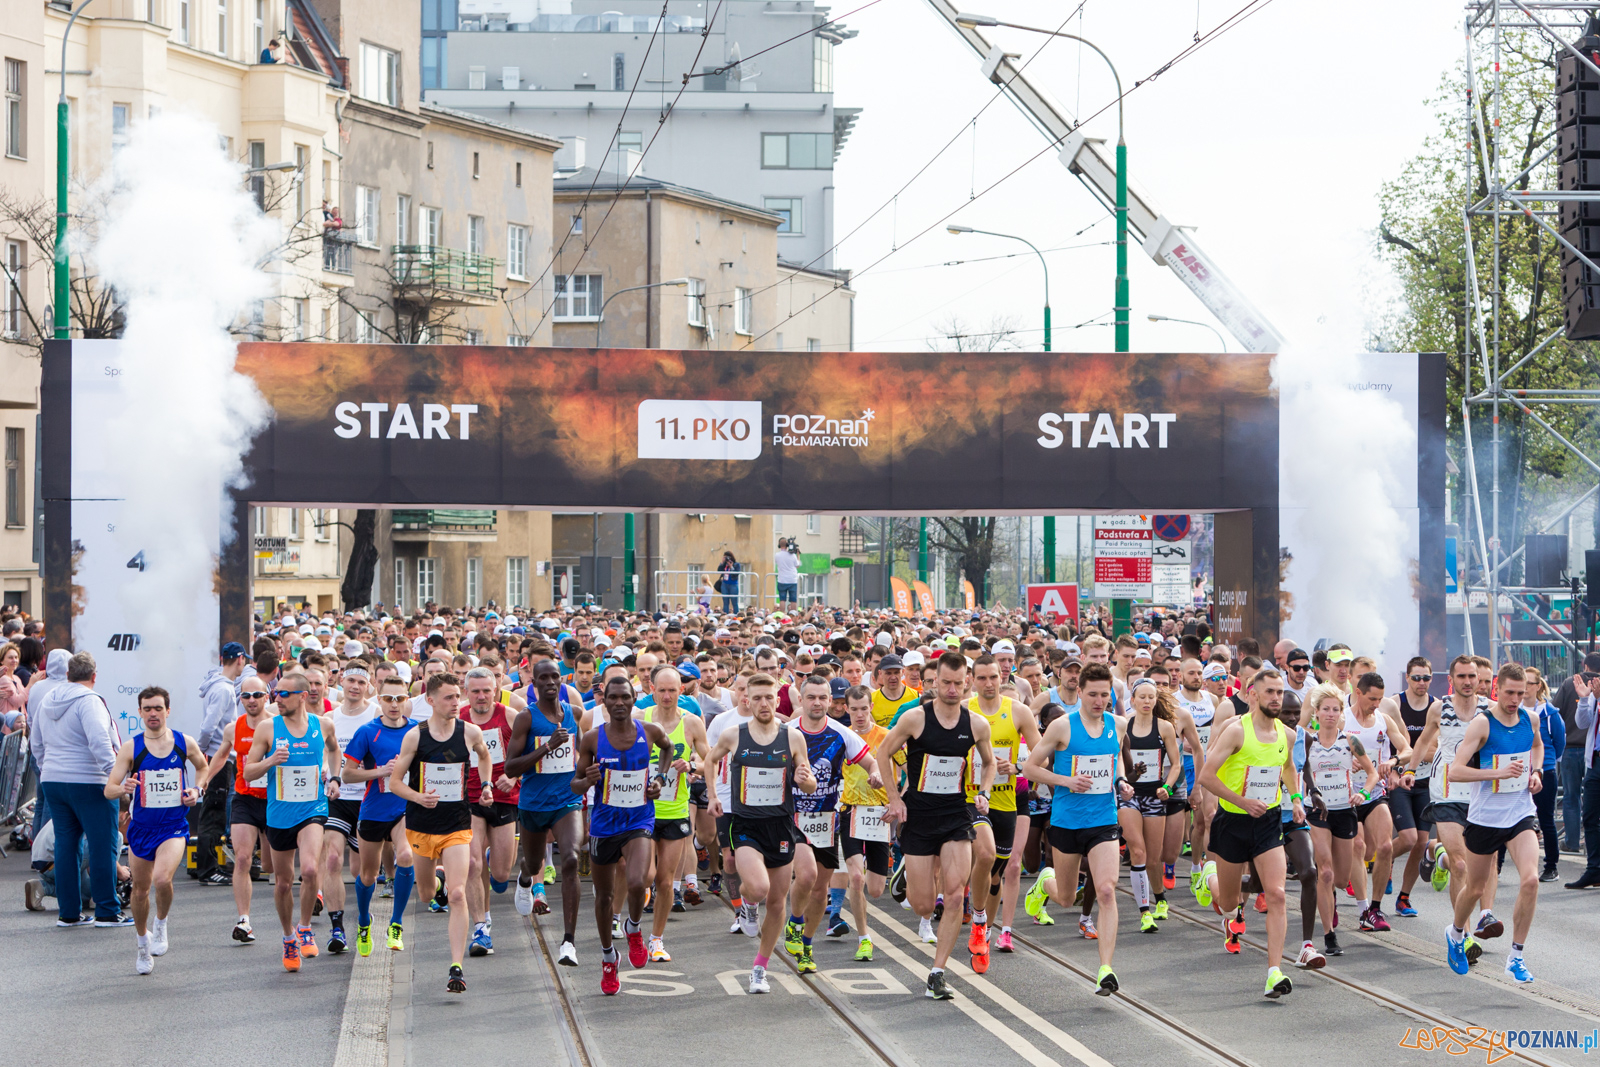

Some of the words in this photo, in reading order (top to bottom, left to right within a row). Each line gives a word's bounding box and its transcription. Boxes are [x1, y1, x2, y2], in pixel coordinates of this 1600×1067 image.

[334, 401, 478, 440] START
[655, 417, 686, 440] 11.
[692, 418, 750, 441] PKO
[1036, 412, 1176, 448] START
[773, 434, 868, 447] PÓŁMARATON
[1098, 530, 1140, 539] Podstrefa
[1142, 530, 1149, 539] A
[1040, 589, 1069, 616] A
[1218, 586, 1235, 606] Leave
[1235, 590, 1248, 611] your
[1218, 612, 1242, 638] footprint
[546, 746, 571, 759] ROP
[929, 770, 958, 778] TARASIUK
[1080, 769, 1109, 778] KULKA
[148, 781, 179, 792] 11343
[293, 777, 307, 787] 25
[612, 783, 643, 792] MUMO
[1317, 783, 1347, 791] STELMACH
[803, 822, 829, 833] 4888
[620, 968, 913, 997] BUS
